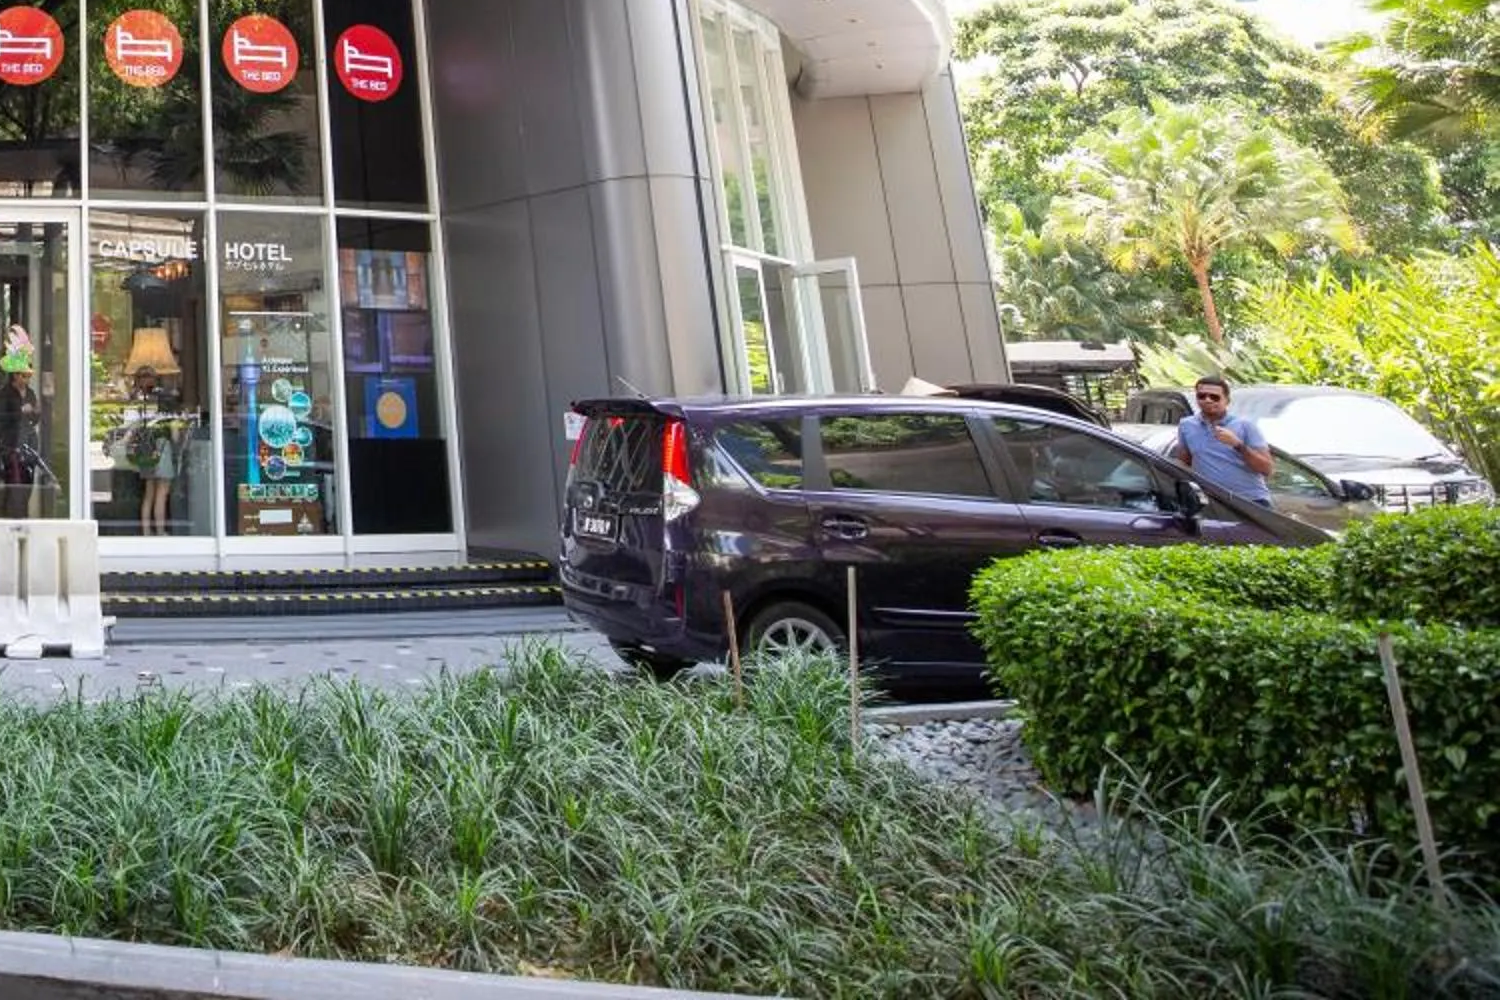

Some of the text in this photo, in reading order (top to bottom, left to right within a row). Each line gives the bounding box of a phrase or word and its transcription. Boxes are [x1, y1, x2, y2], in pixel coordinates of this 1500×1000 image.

[1, 62, 44, 73] THE BED
[124, 65, 165, 77] THE BED
[242, 70, 281, 81] THE BED
[351, 78, 387, 91] THE BED
[99, 239, 292, 262] CAPSULE HOTEL
